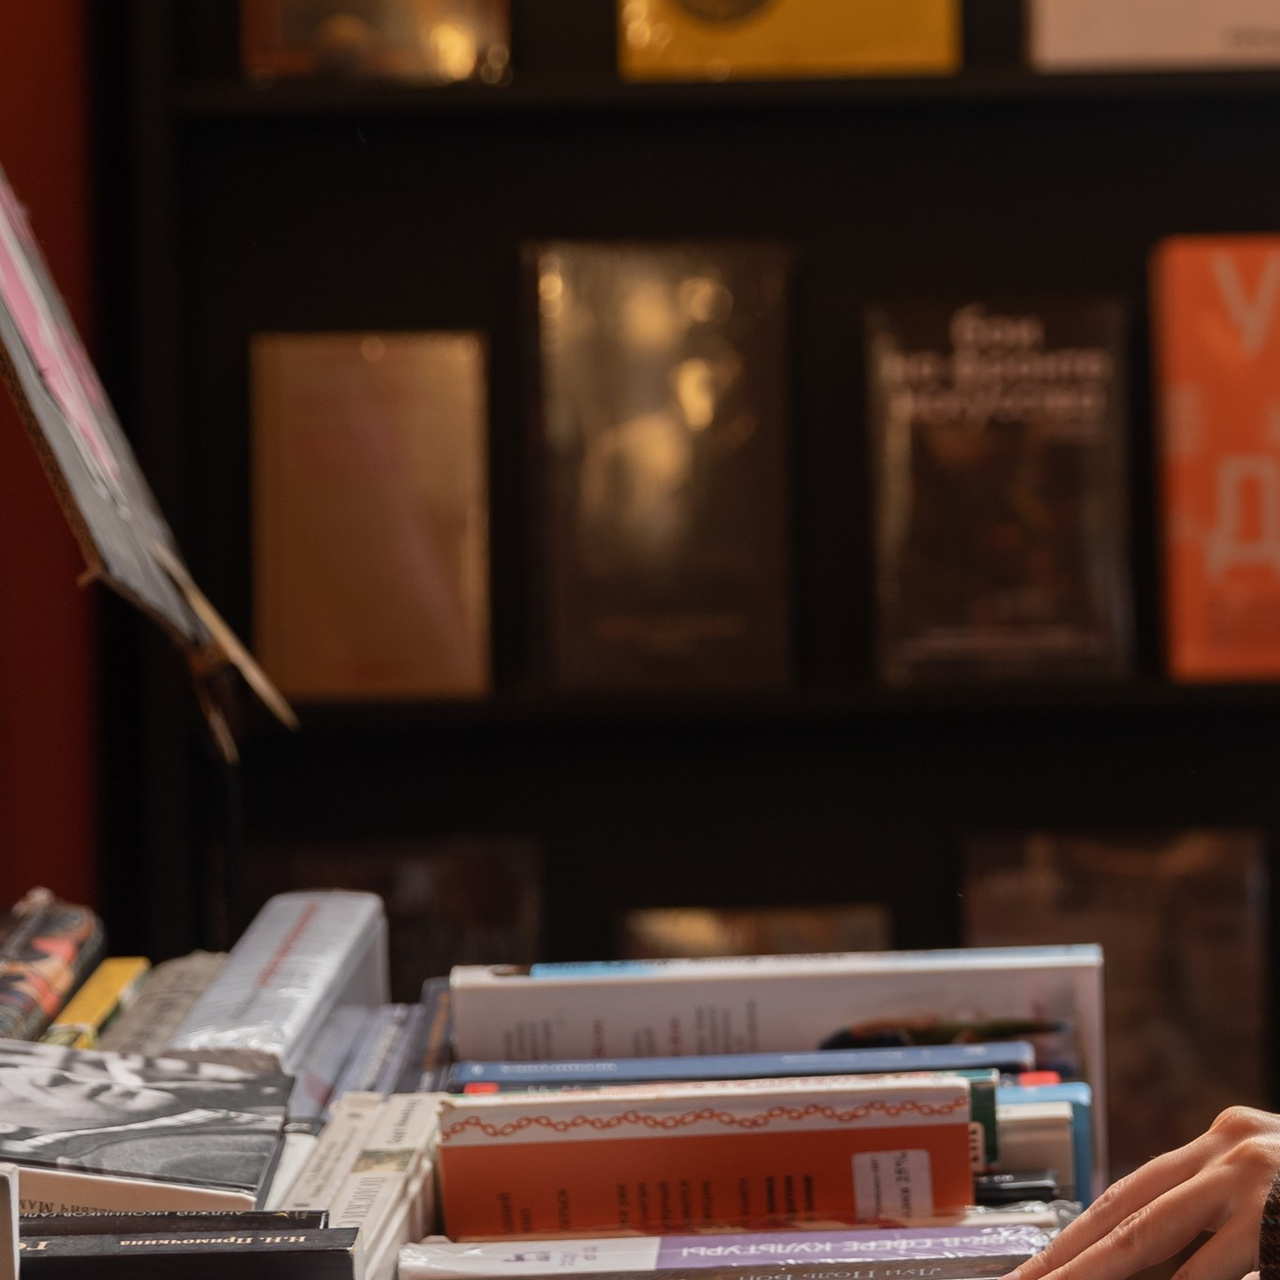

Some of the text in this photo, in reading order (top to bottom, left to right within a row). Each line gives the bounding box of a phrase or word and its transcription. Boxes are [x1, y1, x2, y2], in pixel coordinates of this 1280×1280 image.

[120, 1236, 254, 1246] Примочкина
[841, 1238, 932, 1253] СФЕРЕ
[680, 1240, 832, 1258] КУЛЬТУРЫ
[802, 1269, 874, 1280] Поль
[884, 1267, 942, 1278] Луи
